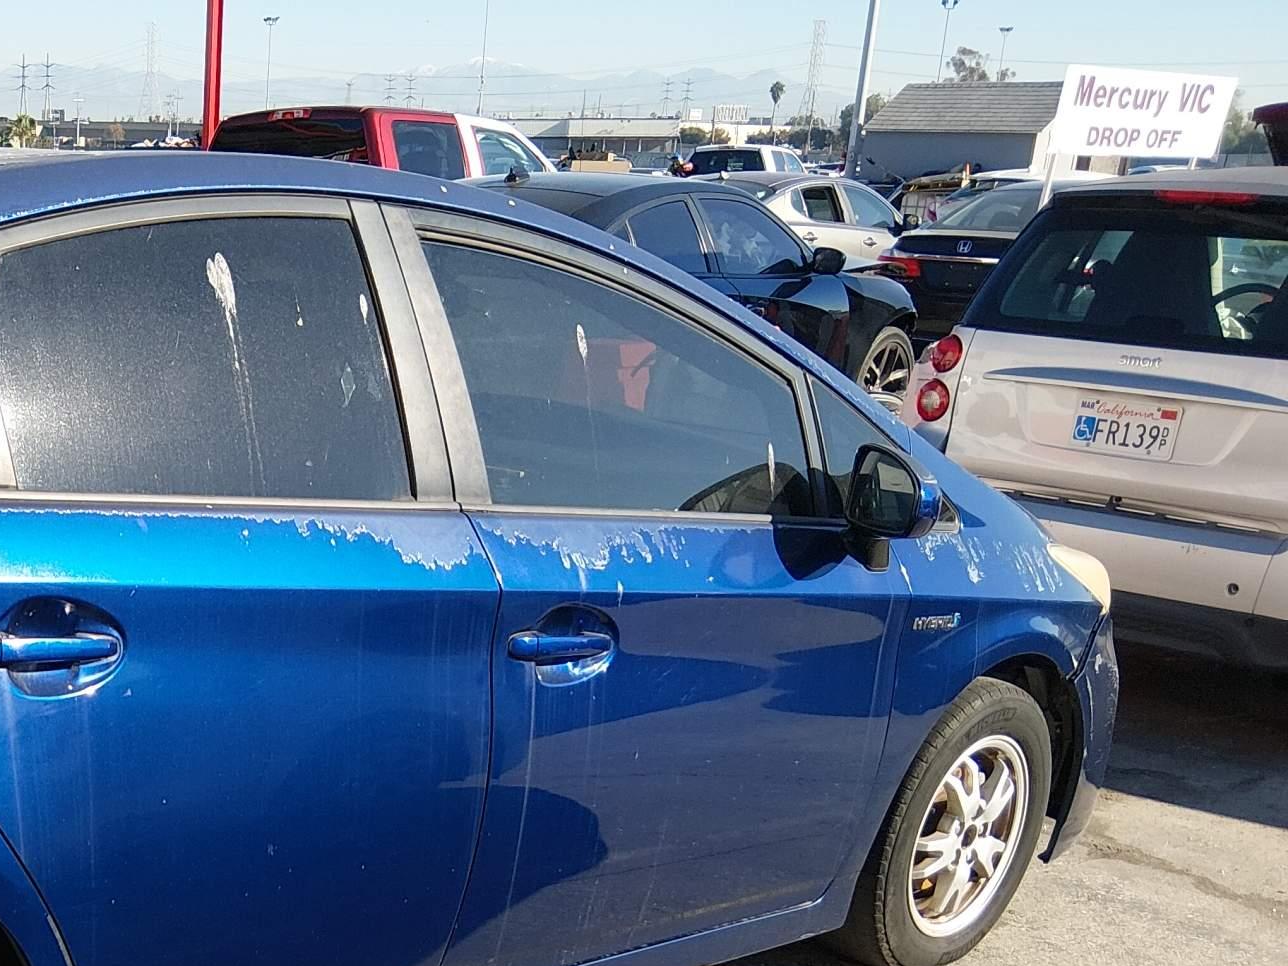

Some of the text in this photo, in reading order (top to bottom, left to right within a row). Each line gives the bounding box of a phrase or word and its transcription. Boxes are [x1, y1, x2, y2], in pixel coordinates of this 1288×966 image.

[1073, 75, 1215, 118] Mercury VIC
[1086, 126, 1182, 149] DROP OFF
[1119, 354, 1162, 368] smart
[1096, 401, 1155, 420] California
[1092, 418, 1160, 450] FR139
